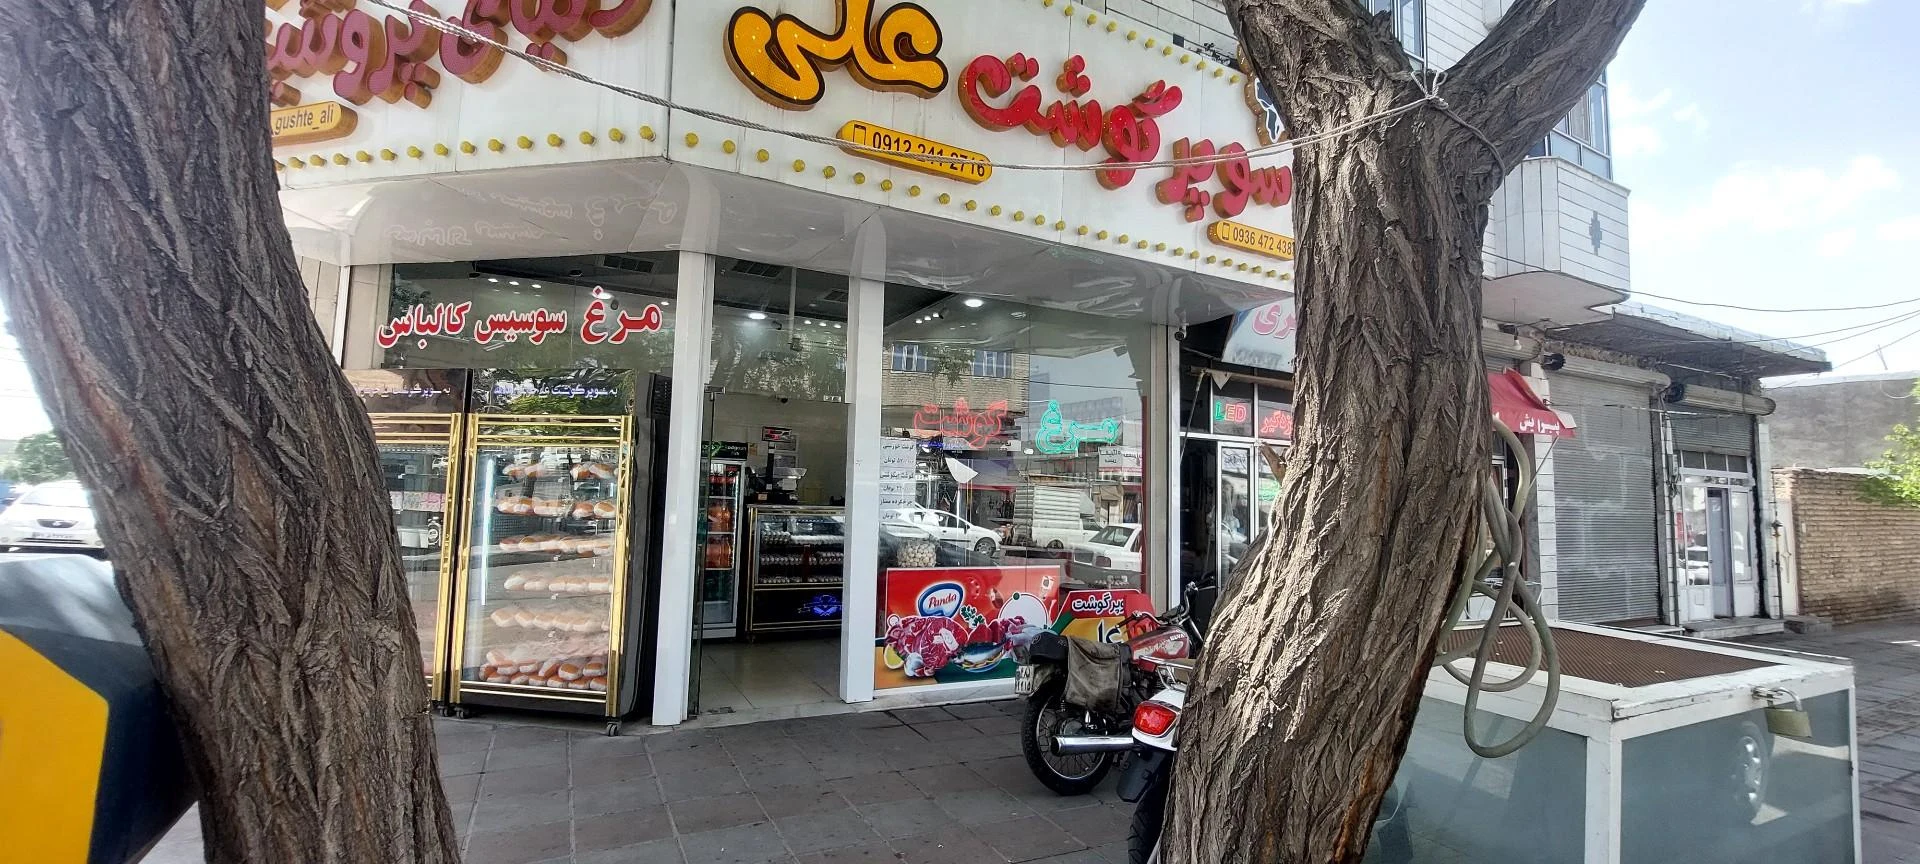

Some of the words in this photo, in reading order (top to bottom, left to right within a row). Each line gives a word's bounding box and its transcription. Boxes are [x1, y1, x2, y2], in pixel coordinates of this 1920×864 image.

[723, 0, 948, 109] علی
[872, 131, 912, 156] 0912
[958, 53, 1182, 190] گوشت
[1233, 227, 1255, 245] 0936
[1258, 234, 1274, 250] 472
[377, 301, 472, 349] کالباس
[474, 308, 568, 345] سوسیس
[580, 286, 663, 344] مرغ
[913, 397, 1008, 448] گوشت
[1036, 399, 1118, 454] مرغ
[1215, 401, 1247, 423] LED
[928, 592, 957, 609] Panda
